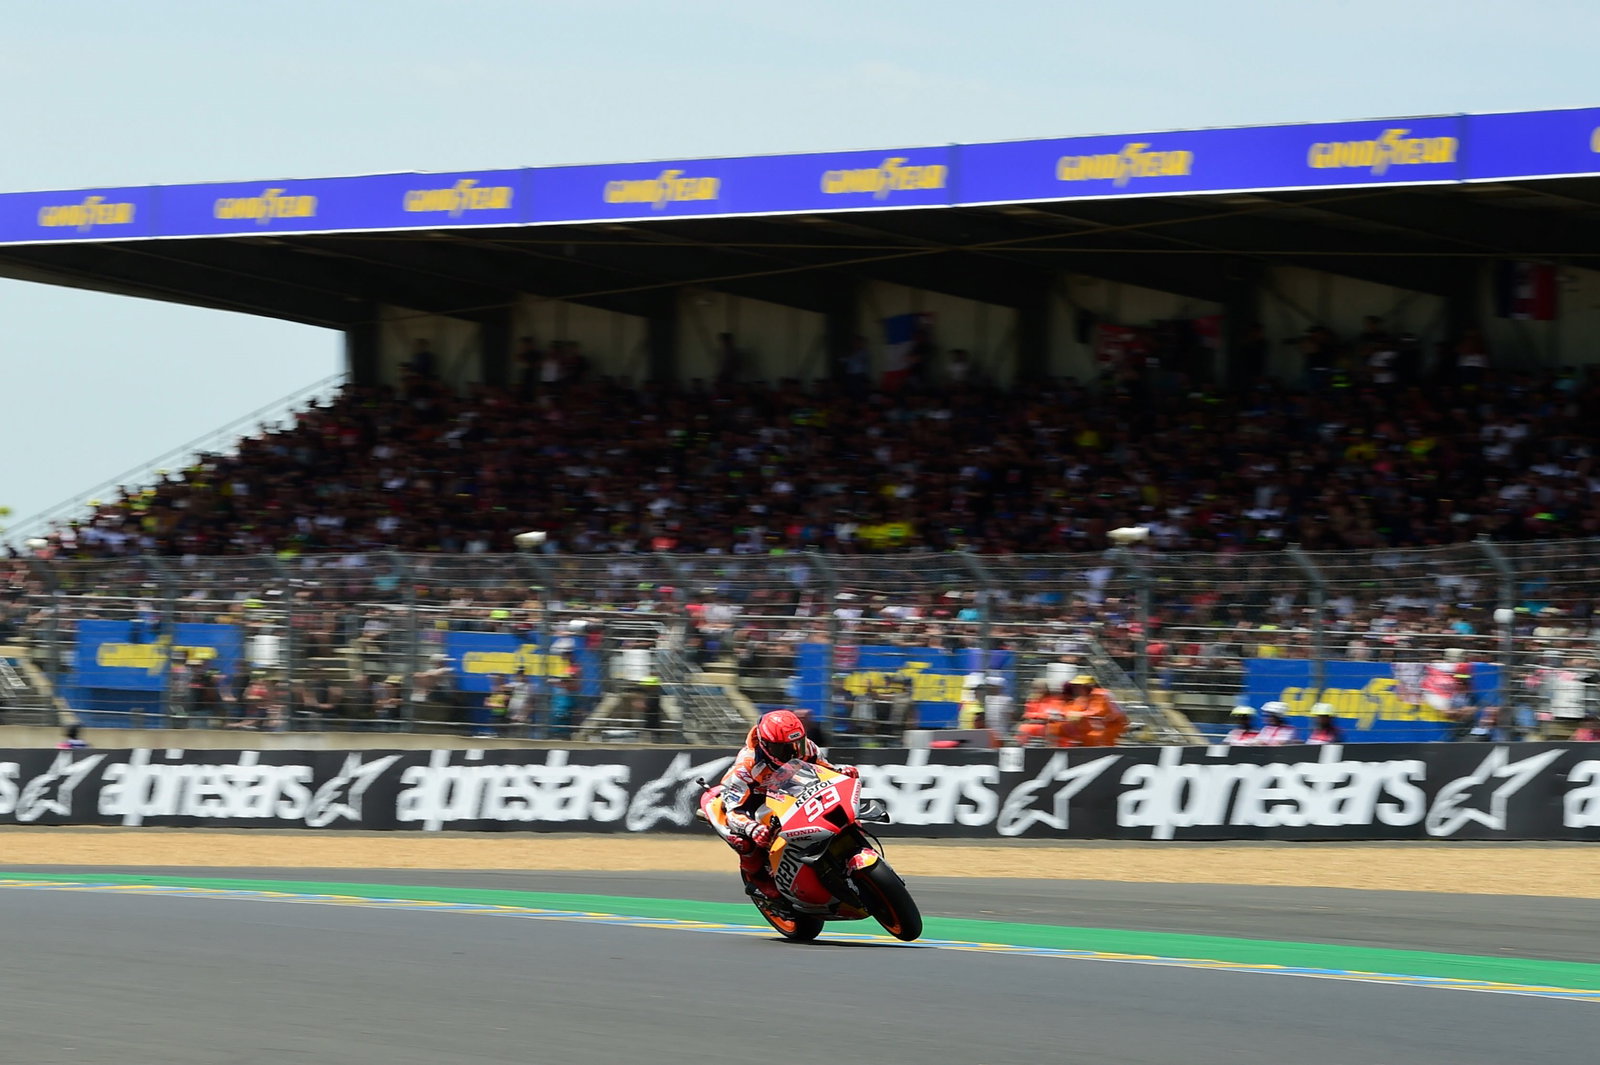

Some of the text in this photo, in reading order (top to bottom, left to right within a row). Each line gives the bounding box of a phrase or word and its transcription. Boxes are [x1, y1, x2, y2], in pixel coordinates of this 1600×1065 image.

[795, 780, 833, 808] REPSOL
[803, 785, 841, 823] 93
[786, 828, 822, 838] HONDA
